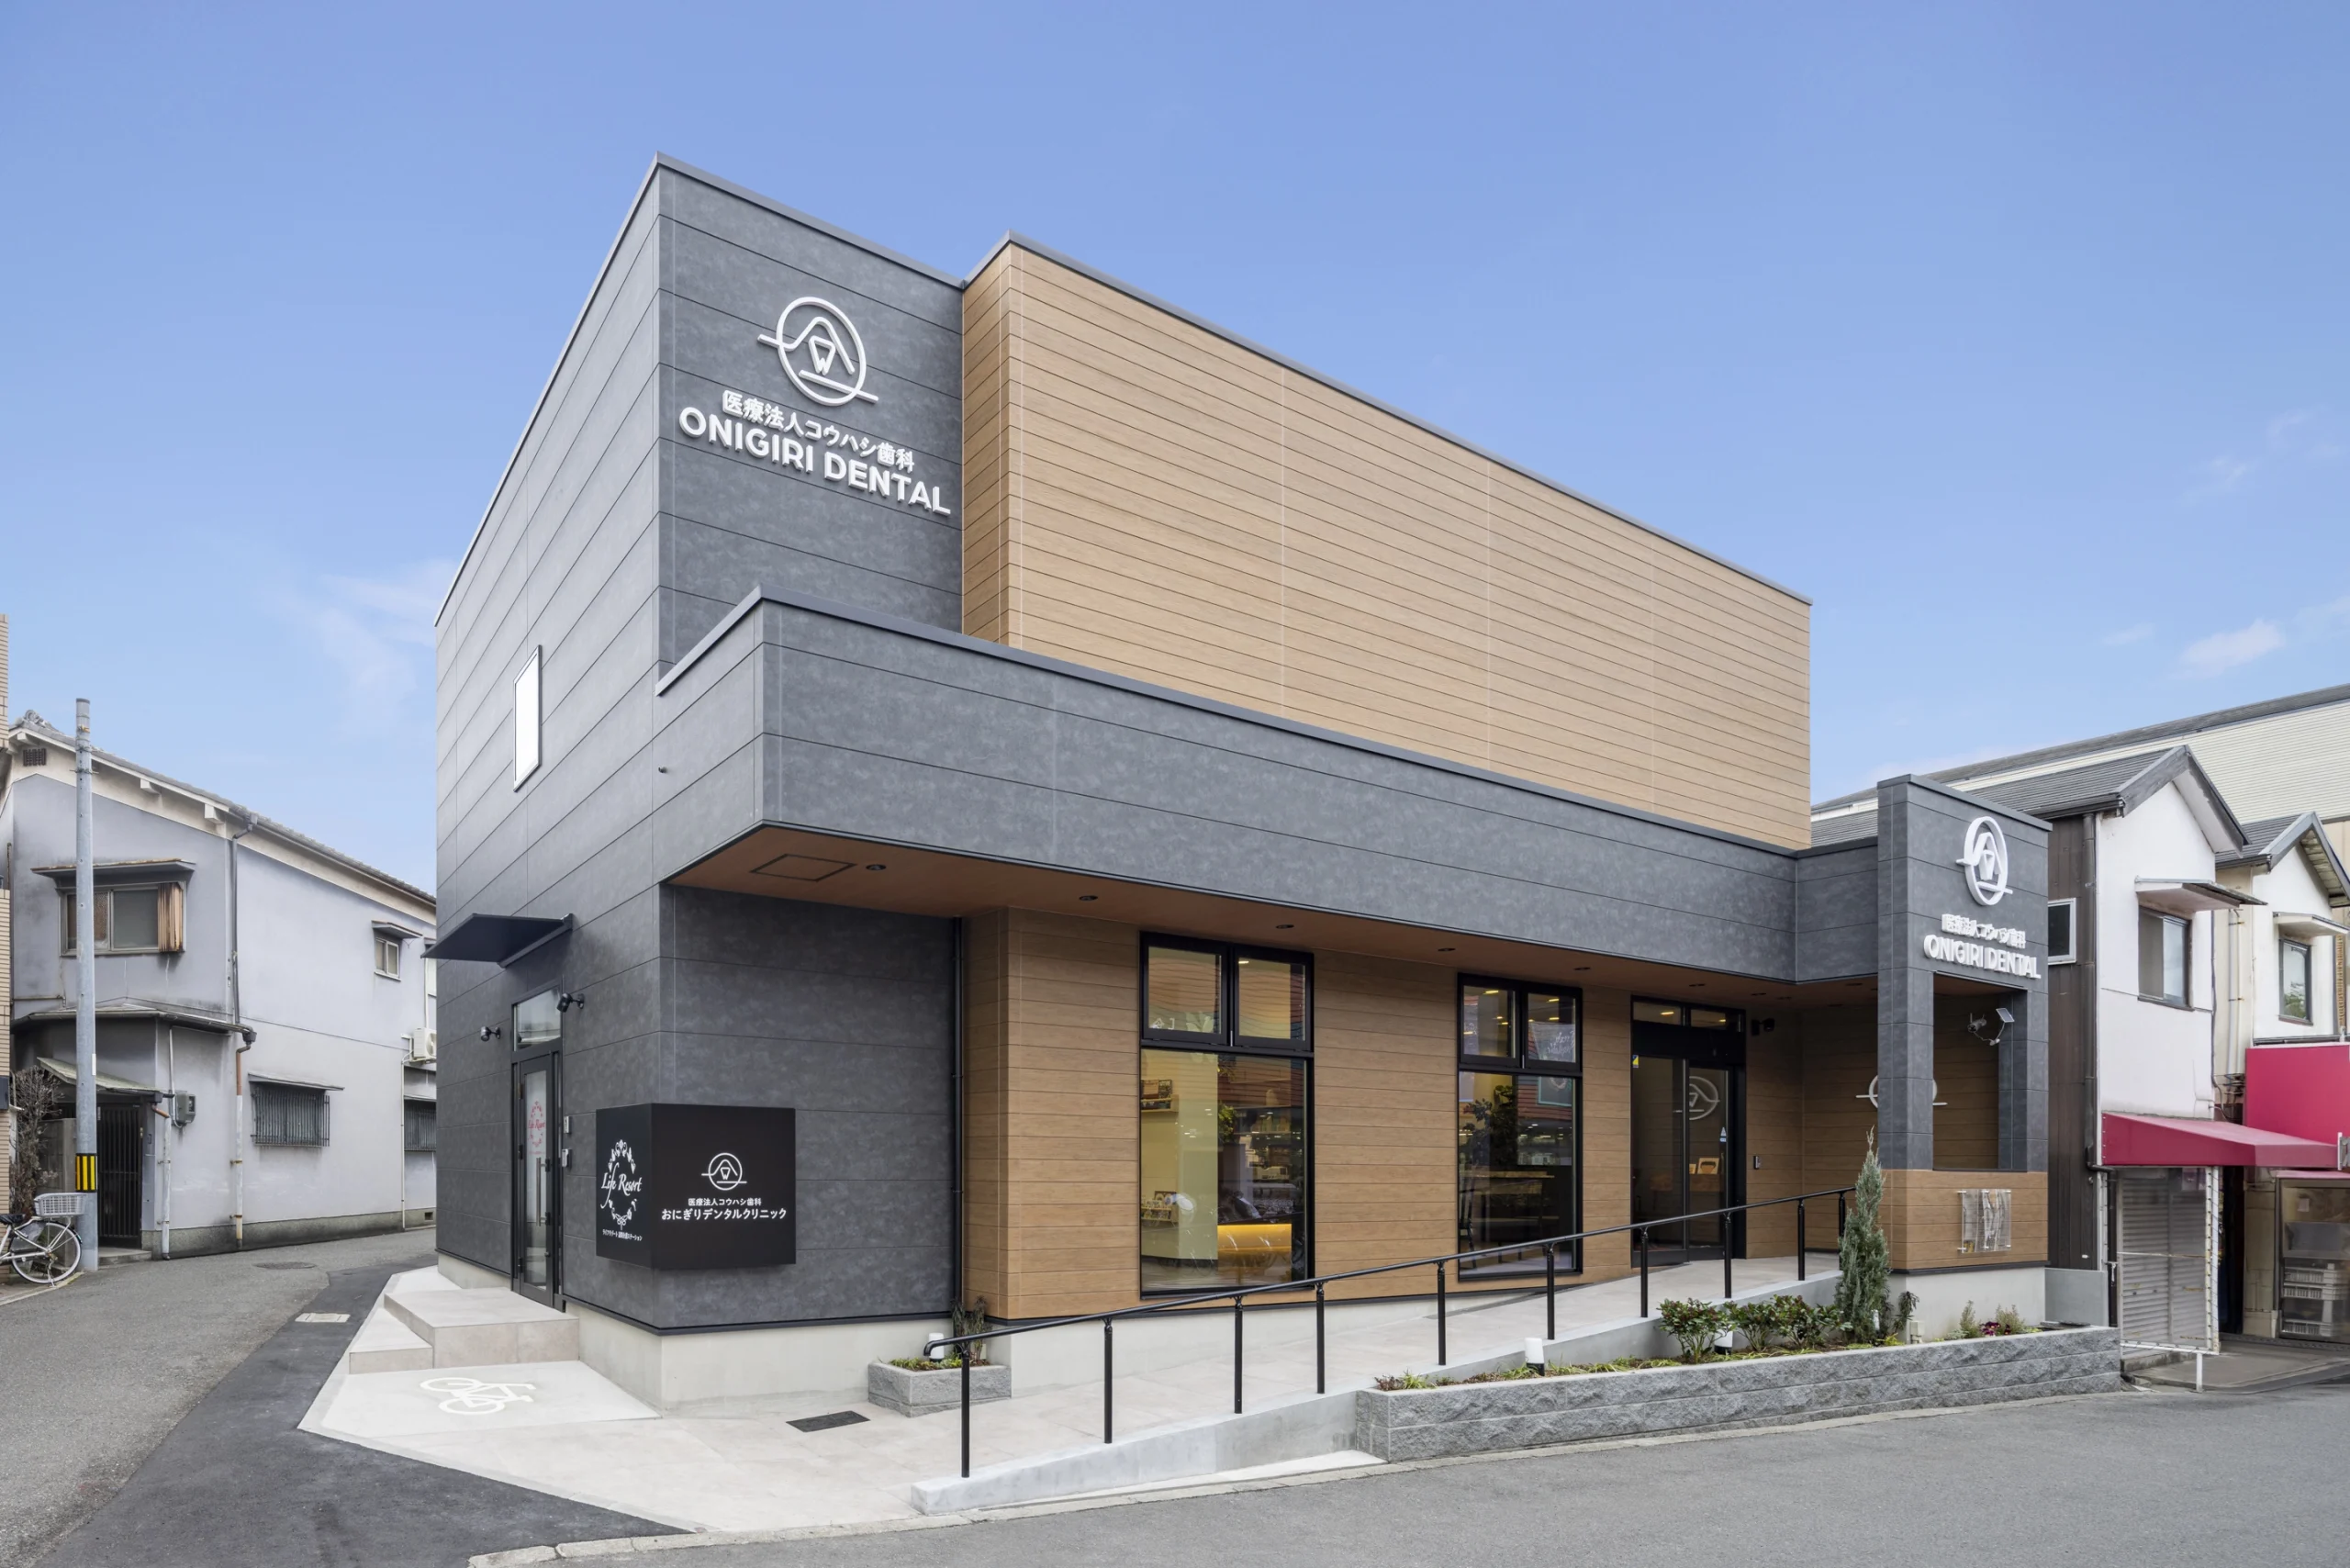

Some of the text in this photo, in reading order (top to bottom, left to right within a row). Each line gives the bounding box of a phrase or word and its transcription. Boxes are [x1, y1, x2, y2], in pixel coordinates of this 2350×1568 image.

[722, 389, 915, 473] 医療法人コウハシ歯科
[678, 406, 951, 516] ONIGIRI DENTAL
[1923, 934, 2042, 980] ONIGIRI DENTAL
[599, 1161, 643, 1209] Life Resort
[688, 1197, 762, 1206] 医療法人コウハシ歯科
[661, 1207, 787, 1221] おにぎりデンタルクリニック
